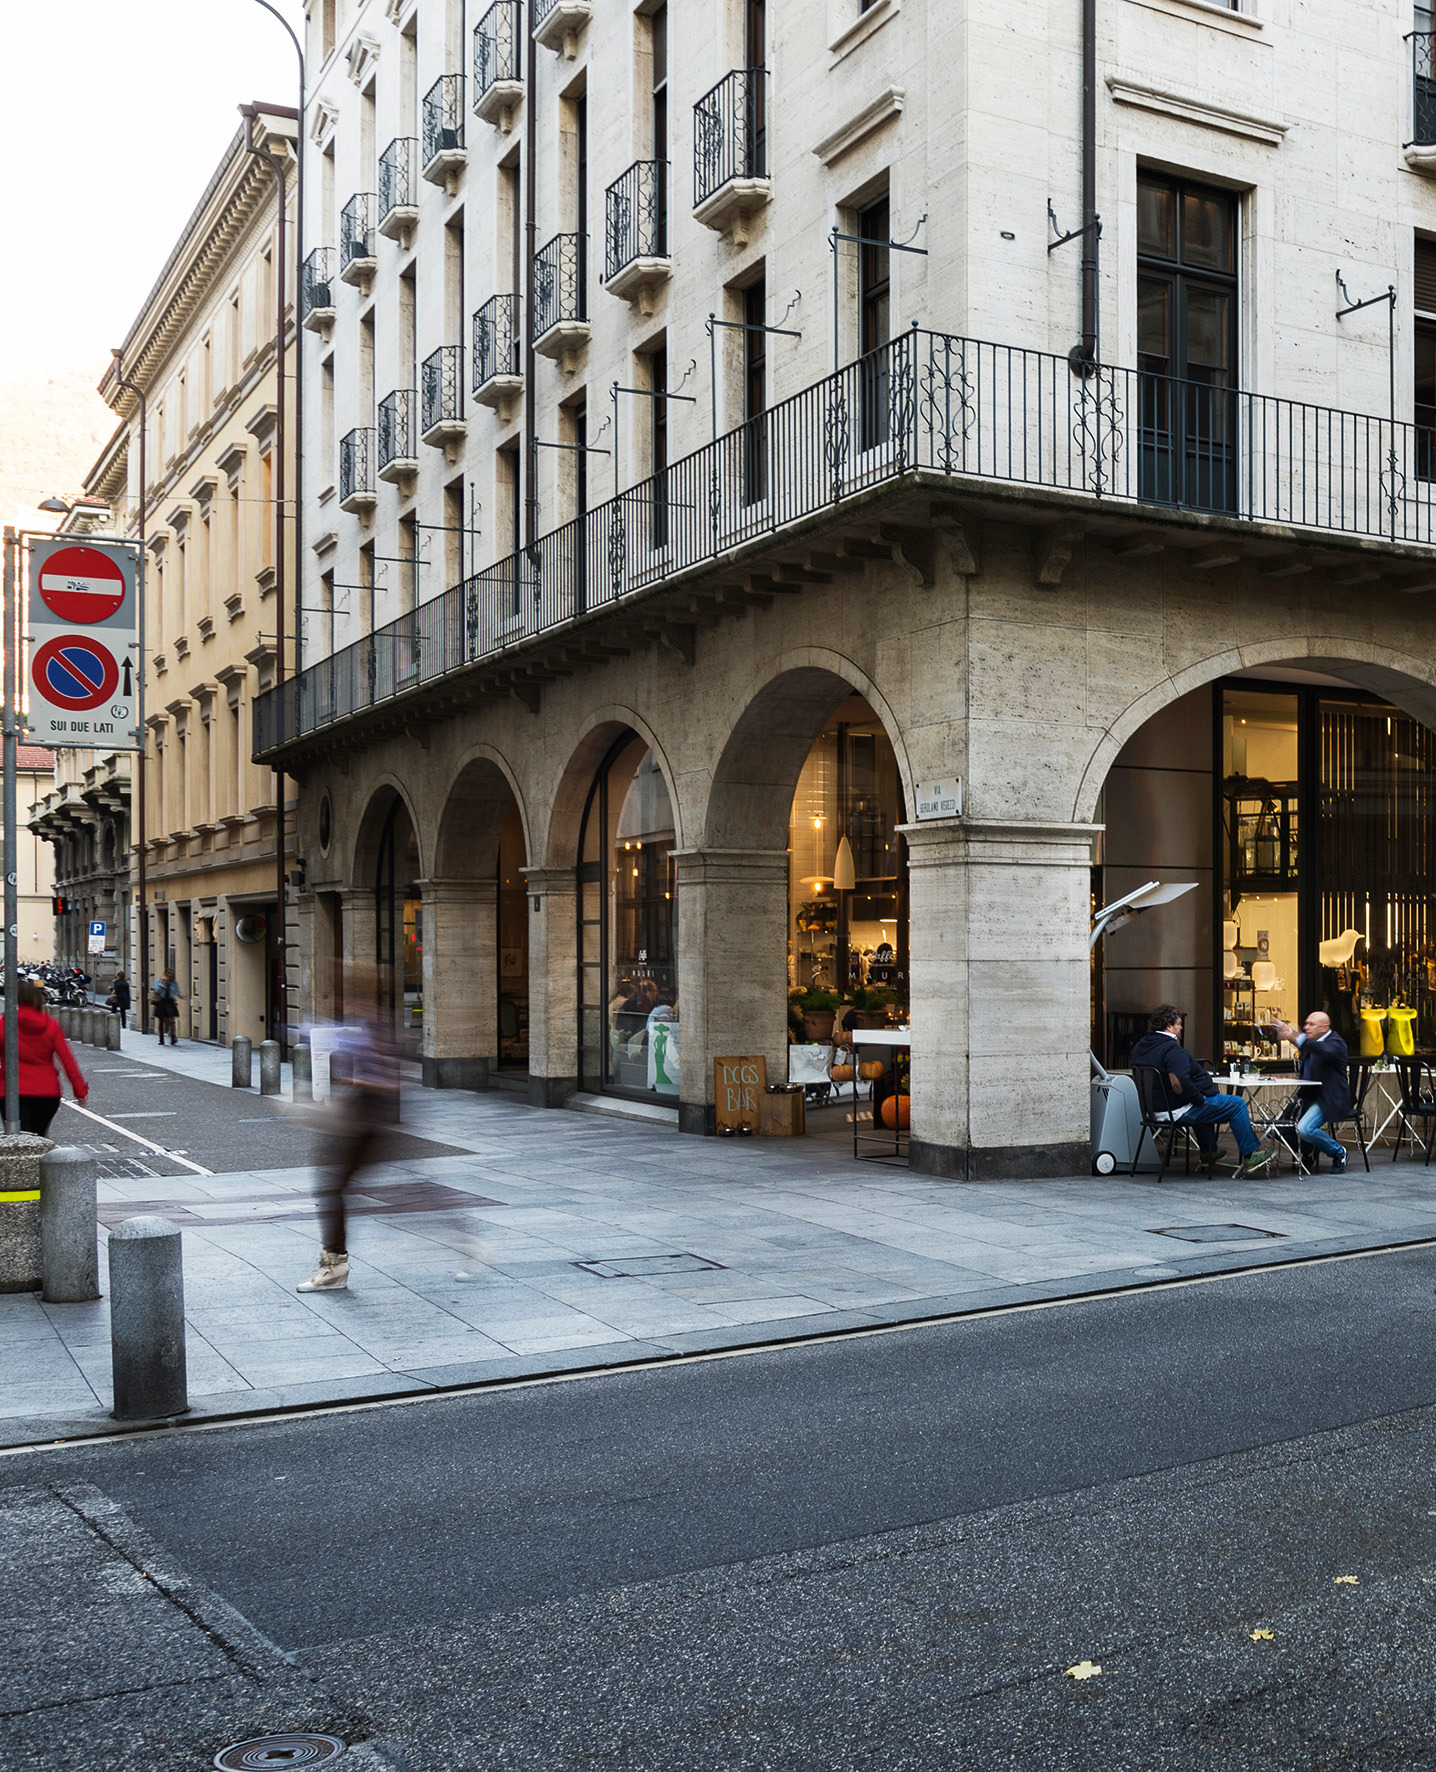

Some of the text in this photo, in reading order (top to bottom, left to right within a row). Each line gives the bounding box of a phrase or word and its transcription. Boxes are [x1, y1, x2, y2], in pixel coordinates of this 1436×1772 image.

[50, 720, 114, 733] SUI DUE LATI
[94, 923, 102, 934] P
[848, 971, 904, 980] MAUR
[723, 1065, 759, 1085] DOGS
[727, 1087, 757, 1112] BAR
